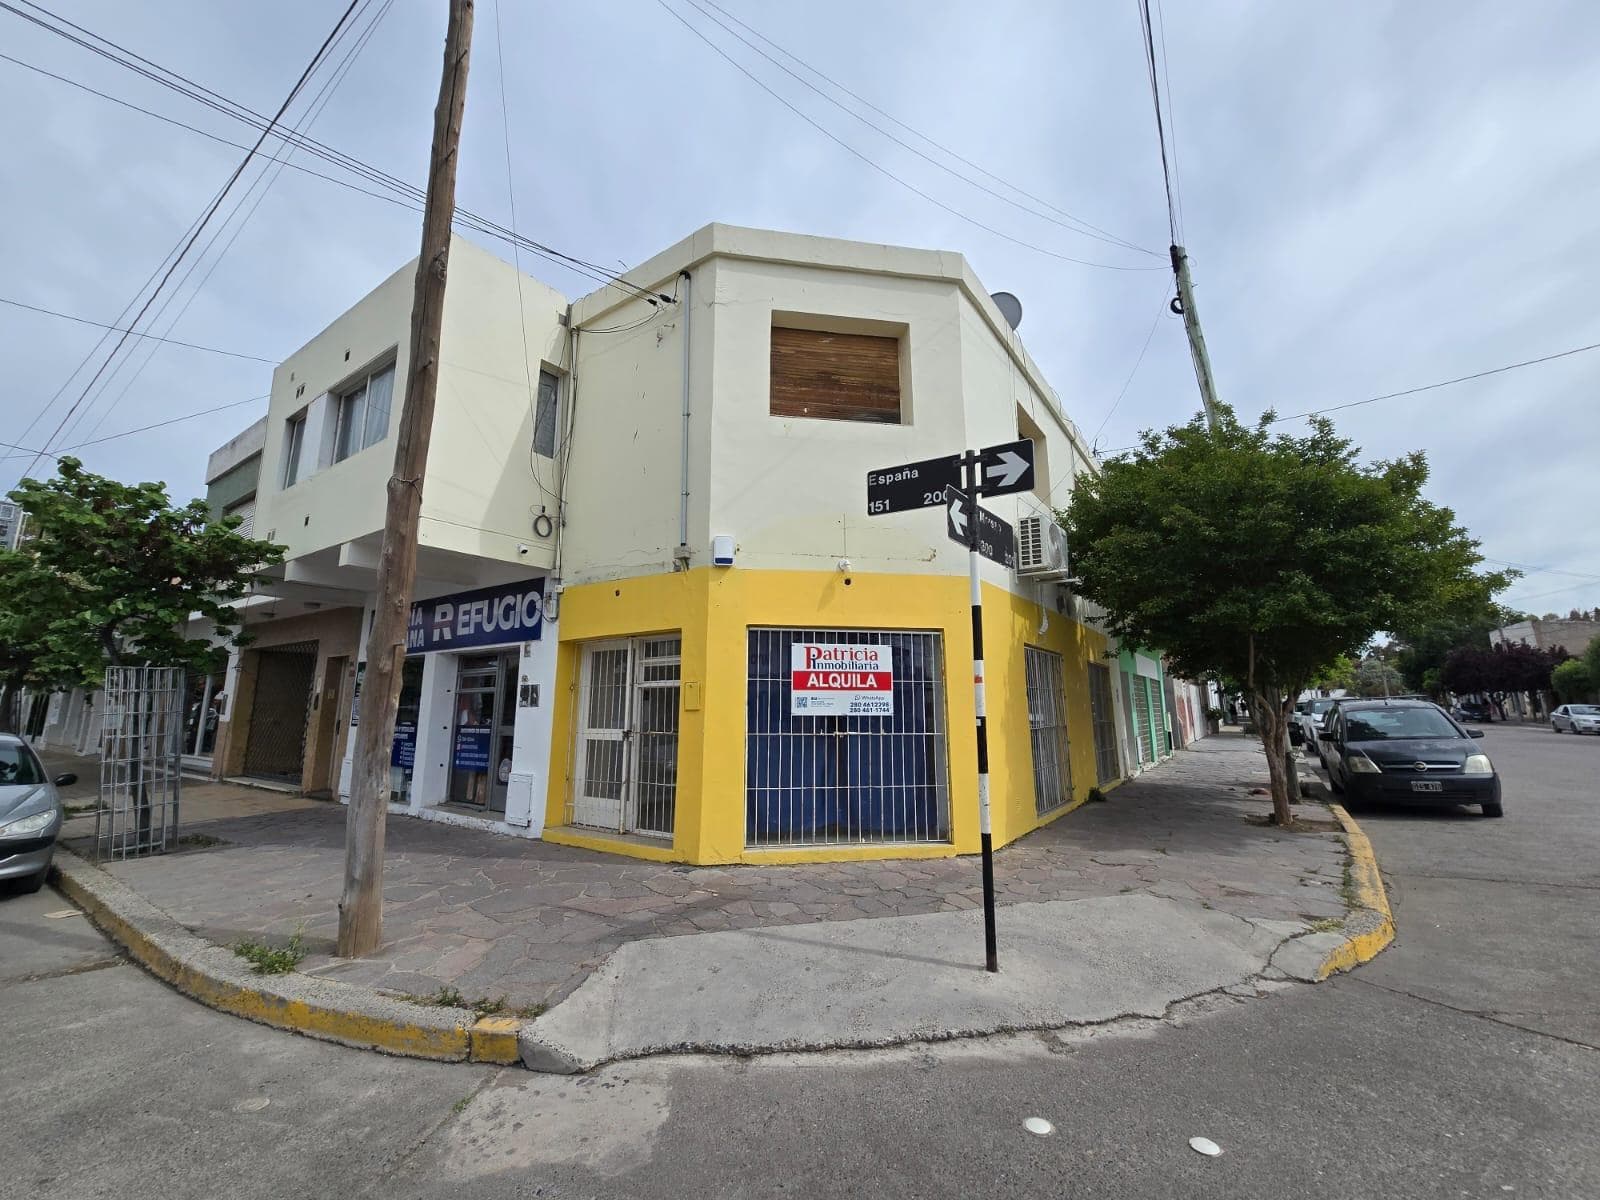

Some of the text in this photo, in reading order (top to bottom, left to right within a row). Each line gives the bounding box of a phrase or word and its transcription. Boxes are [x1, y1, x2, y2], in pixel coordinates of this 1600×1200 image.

[868, 467, 919, 486] España
[869, 499, 890, 513] 151
[432, 591, 542, 642] REFUGIO
[804, 646, 879, 669] Patricia
[811, 655, 880, 671] Inmobiliaria
[806, 672, 878, 689] ALQUILA
